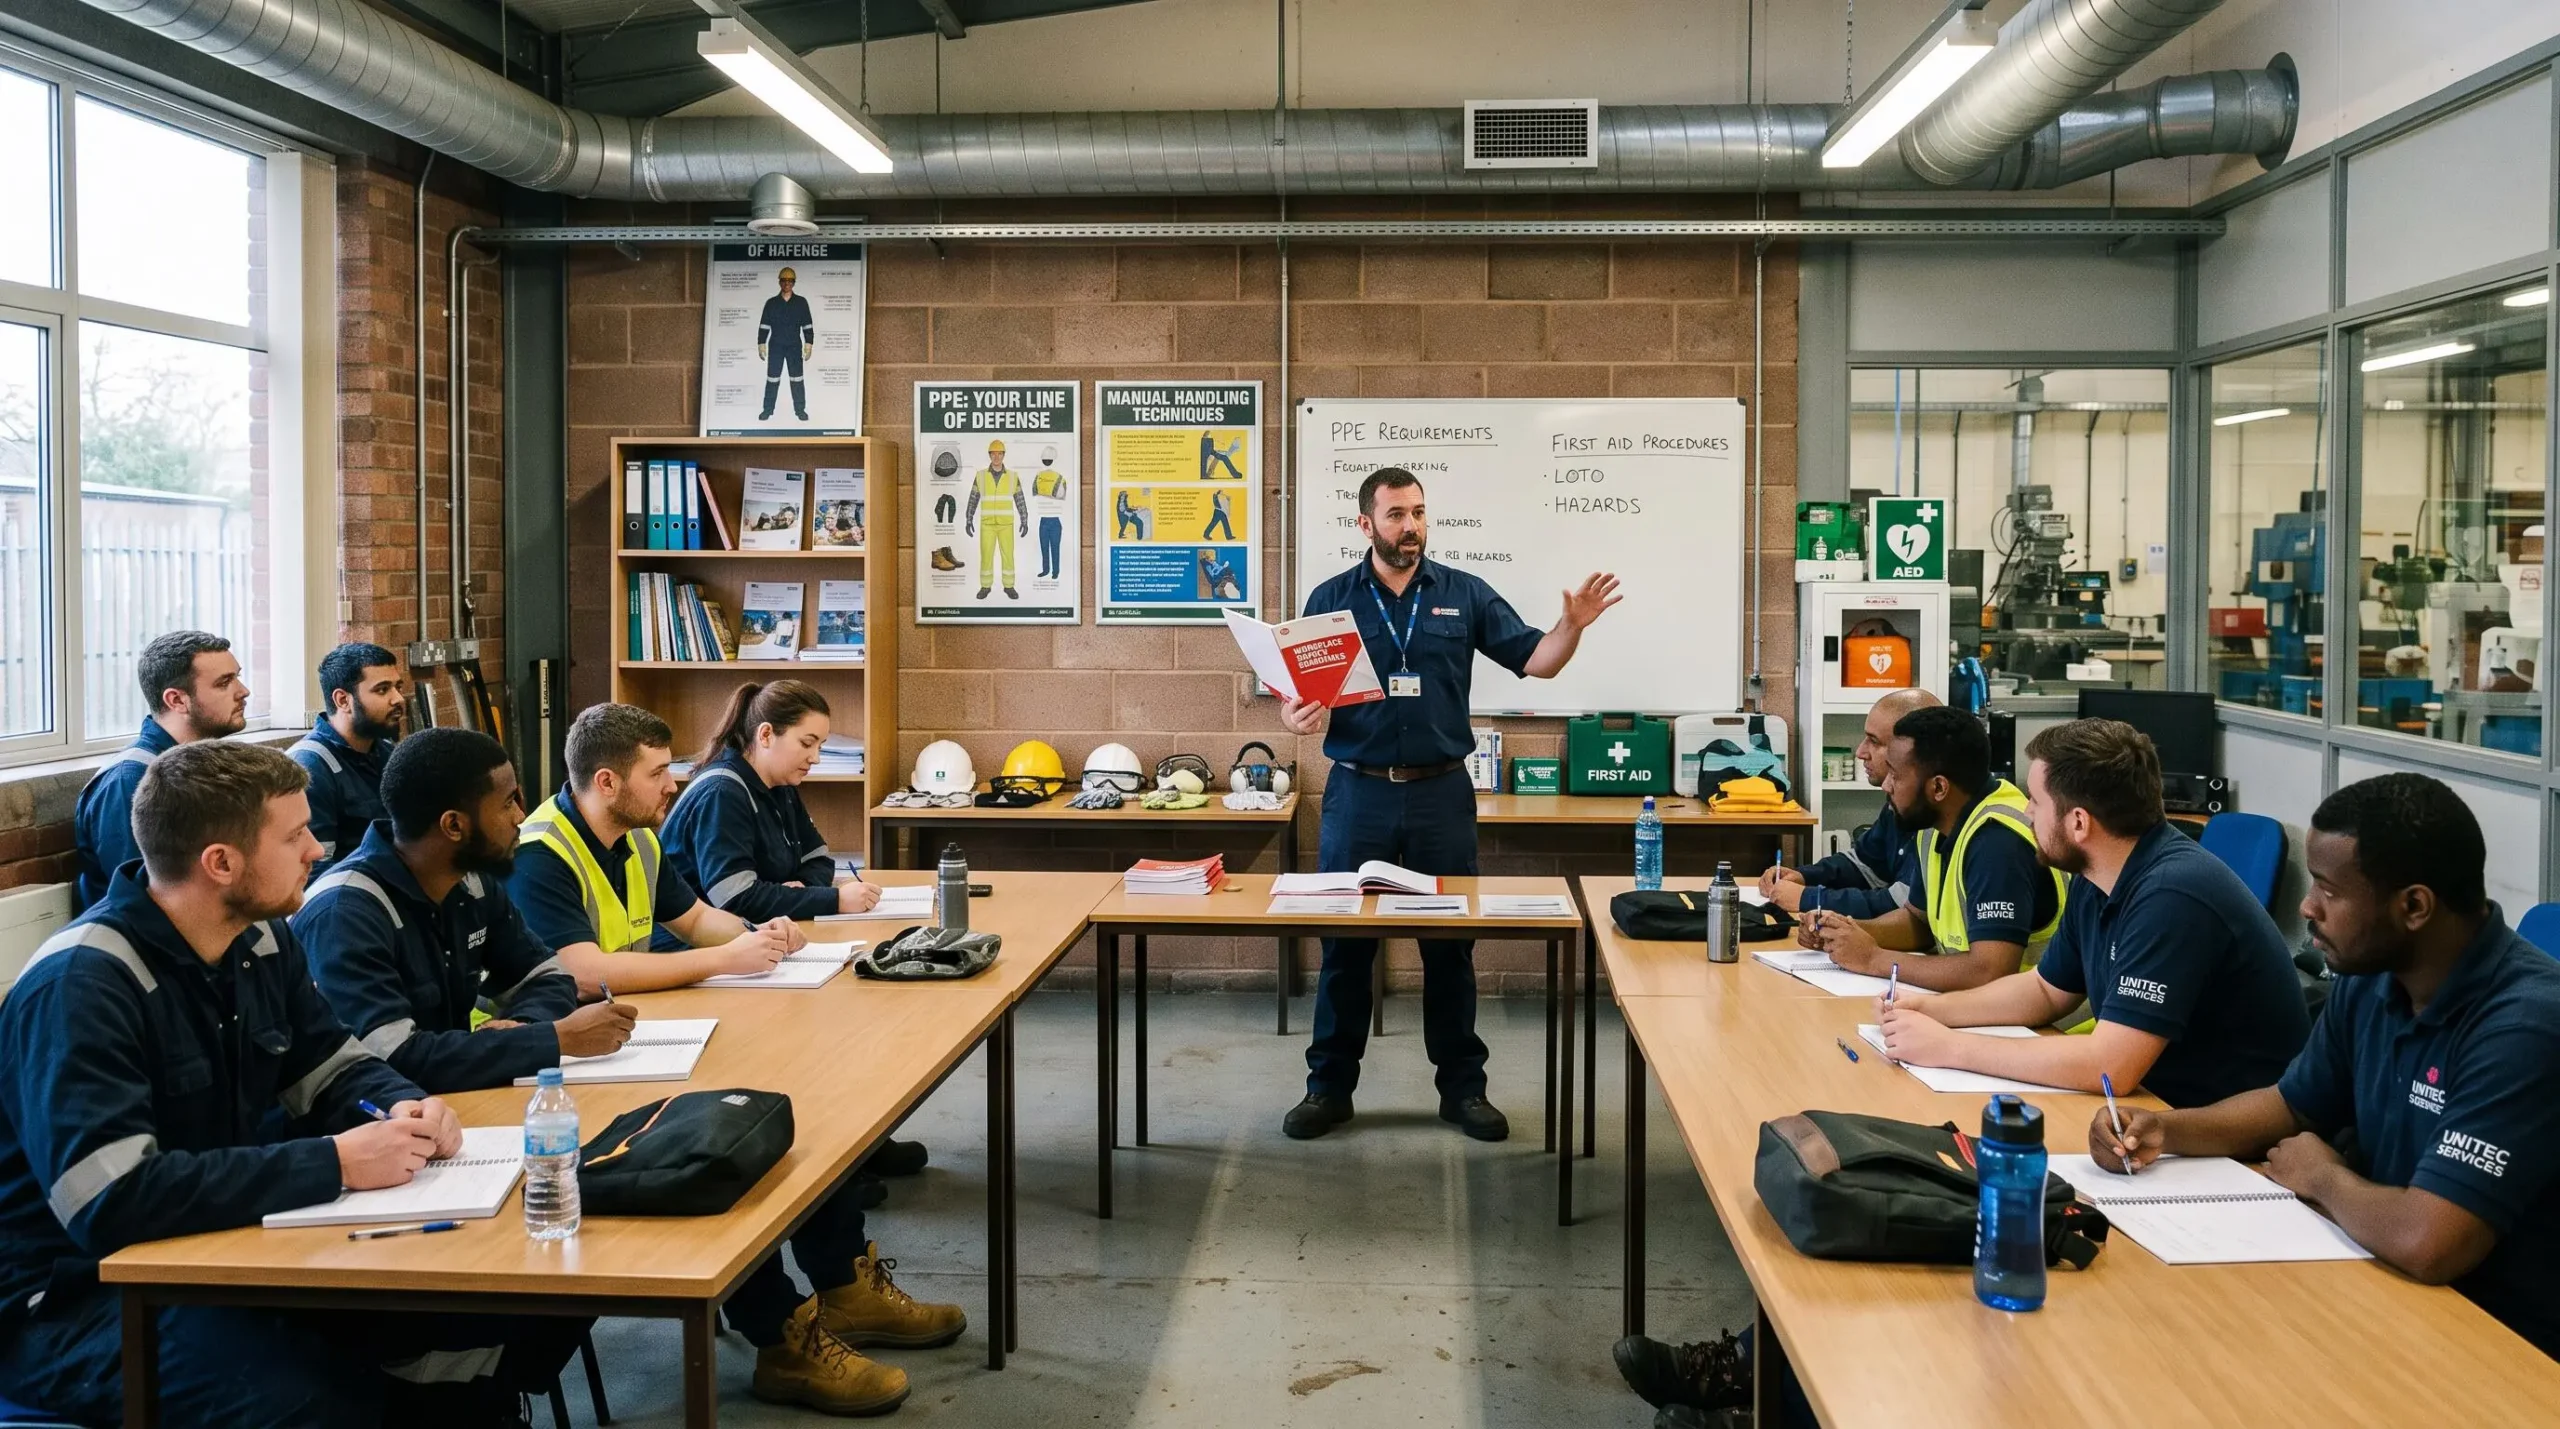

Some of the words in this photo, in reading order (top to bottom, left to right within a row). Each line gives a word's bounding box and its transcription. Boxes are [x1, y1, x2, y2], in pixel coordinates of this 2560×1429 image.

[748, 244, 763, 258] OF
[929, 391, 968, 409] PPE:
[973, 391, 1021, 409] YOUR
[1026, 391, 1066, 409] LINE
[1107, 390, 1171, 405] MANUAL
[1174, 390, 1250, 405] HANDLING
[943, 411, 967, 429] OF
[972, 411, 1051, 429] DEFENSE
[1132, 407, 1225, 423] TECHNIQUES
[1331, 422, 1367, 442] PPE
[1607, 436, 1633, 450] AID
[1643, 434, 1729, 451] PROCEDURES
[1554, 468, 1605, 484] LOTO
[1555, 496, 1641, 514] HAZARDS
[1437, 518, 1482, 528] HAZARDS
[1893, 566, 1925, 578] AED
[1587, 769, 1626, 781] FIRST
[1628, 769, 1652, 781] AID
[1976, 901, 2015, 912] UNITEC
[1977, 910, 2015, 919] SERVICE
[2119, 975, 2168, 996] UNITEC
[2117, 985, 2165, 1004] SERVICES
[2411, 1079, 2446, 1104] UNITEC
[2442, 1129, 2511, 1165] UNITEC
[2436, 1143, 2505, 1177] SERVICES
